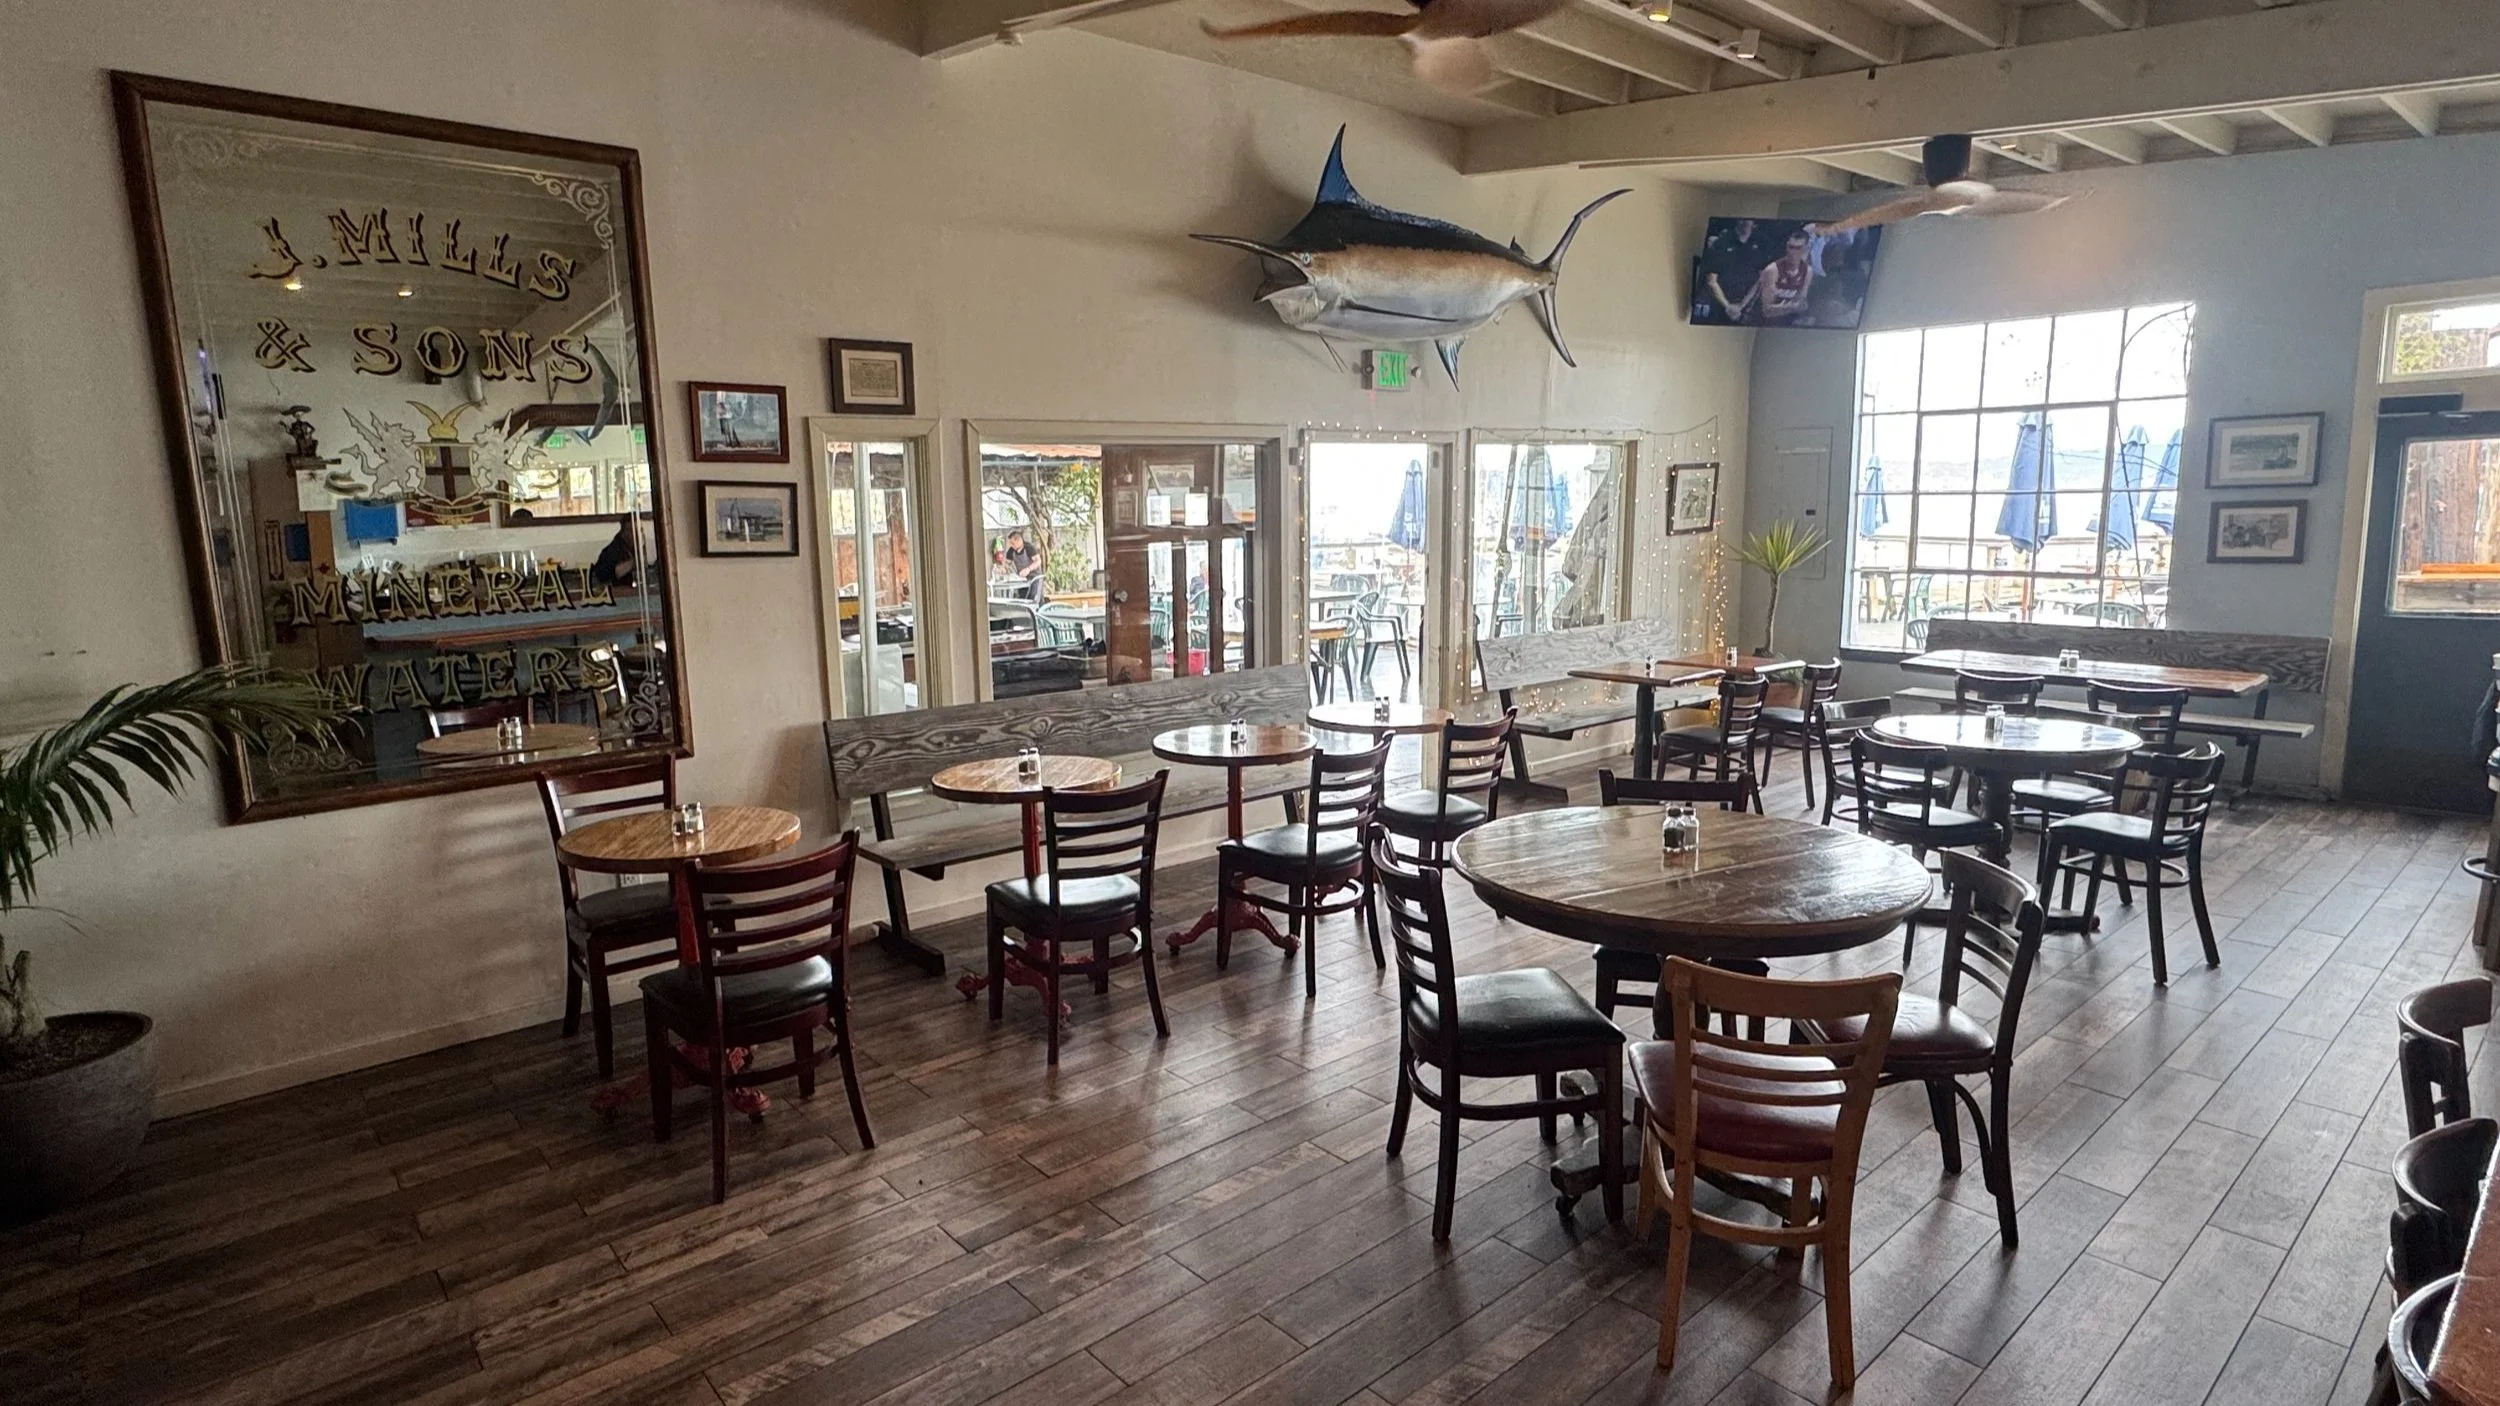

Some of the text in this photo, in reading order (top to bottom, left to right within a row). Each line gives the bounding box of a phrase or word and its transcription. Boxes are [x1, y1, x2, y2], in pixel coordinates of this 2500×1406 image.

[254, 316, 595, 384] & SONS
[1379, 351, 1408, 386] EXIT
[290, 562, 616, 627] MINERAL
[302, 642, 619, 714] WATERS
